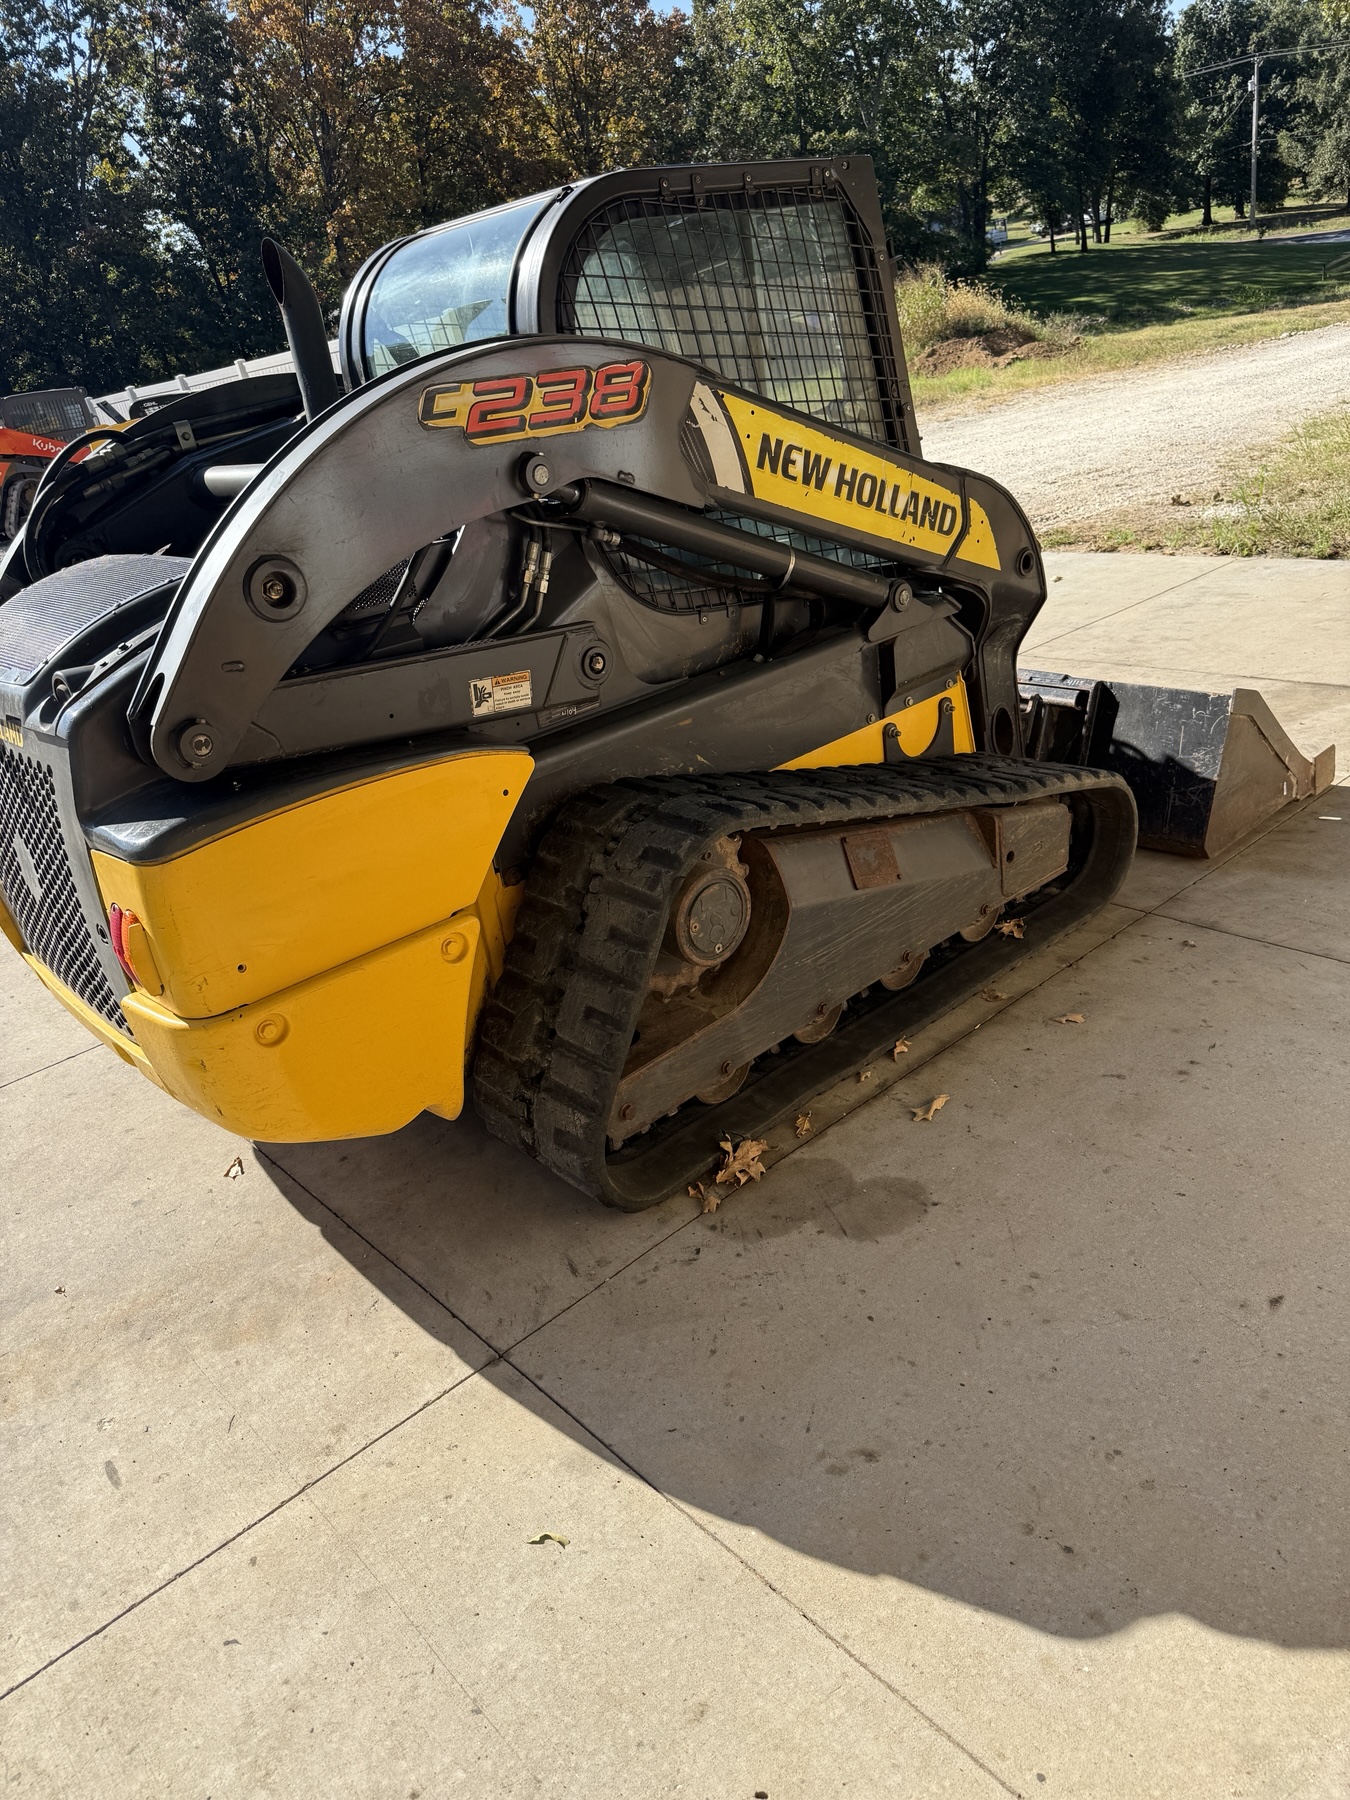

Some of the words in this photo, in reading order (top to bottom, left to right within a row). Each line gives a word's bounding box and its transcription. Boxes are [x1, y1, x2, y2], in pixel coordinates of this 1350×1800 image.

[419, 361, 651, 443] C238
[32, 438, 65, 453] Kubo
[756, 433, 832, 492] NEW
[834, 463, 957, 537] HOLLAND
[501, 673, 528, 683] WARNING
